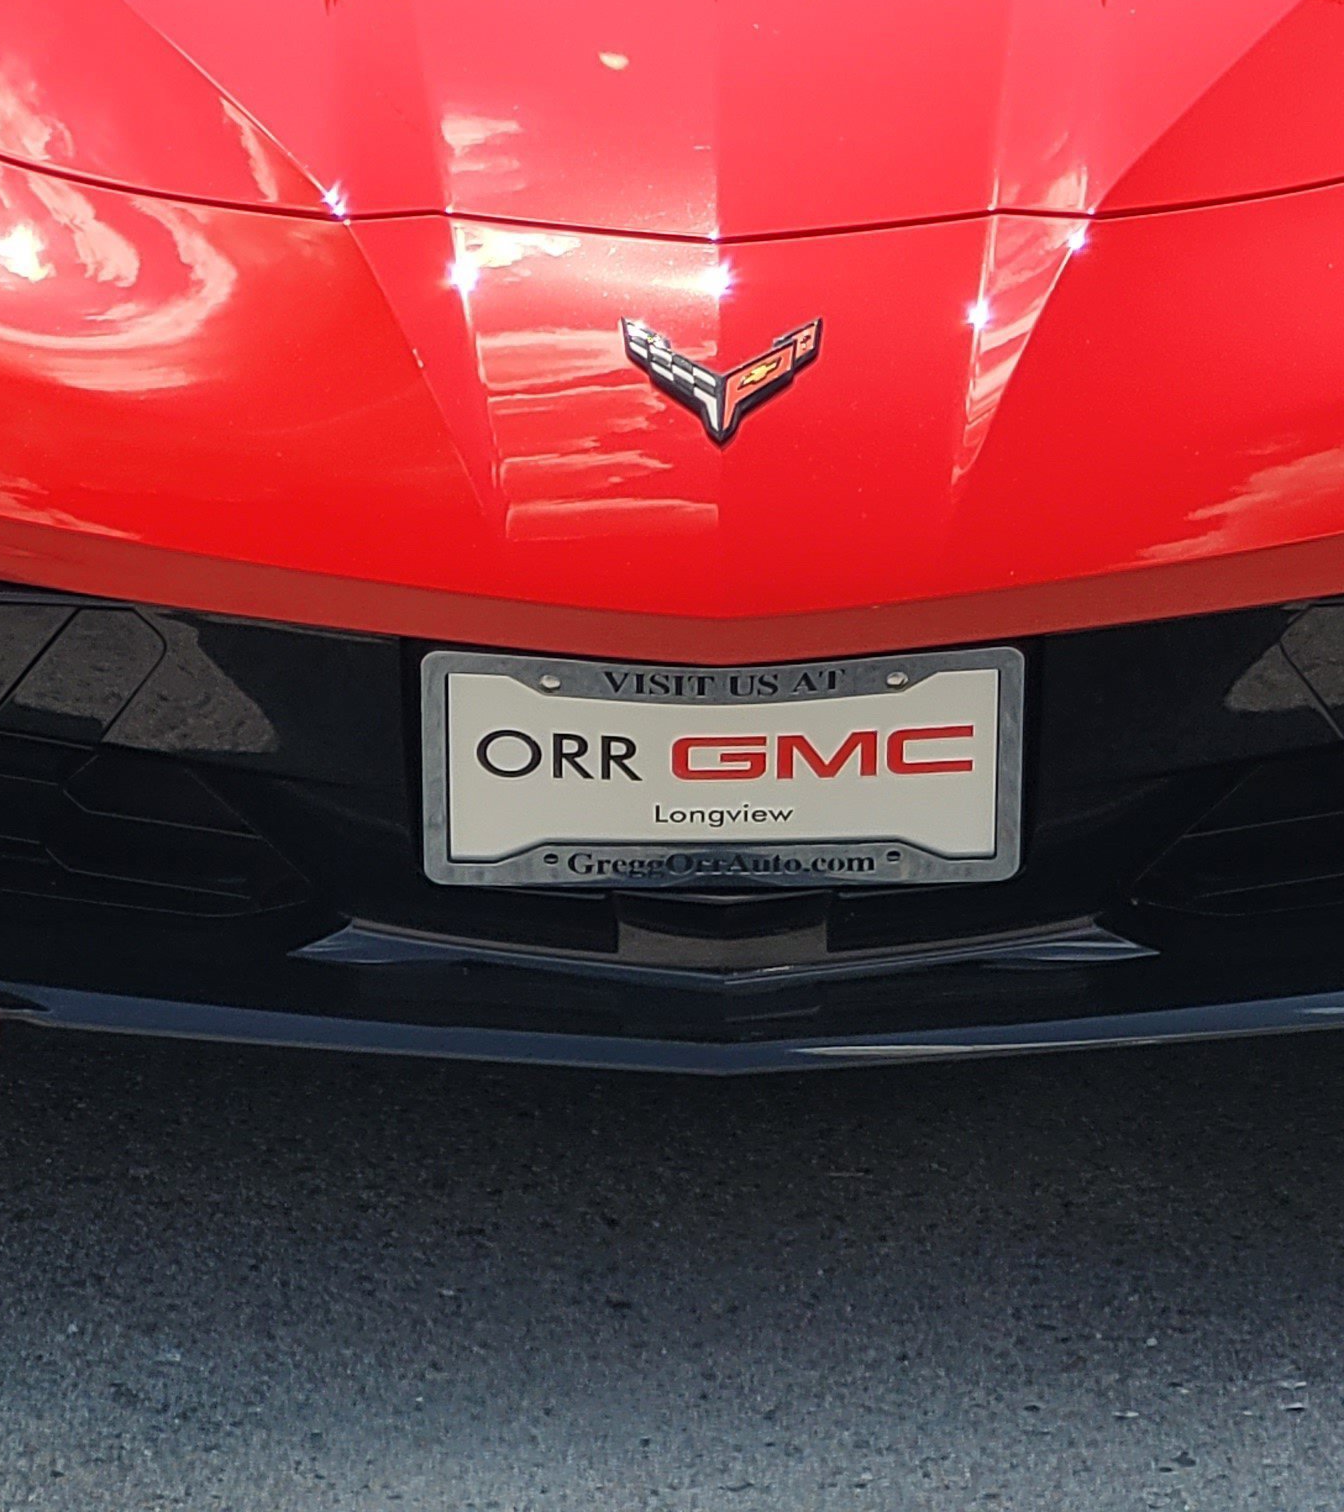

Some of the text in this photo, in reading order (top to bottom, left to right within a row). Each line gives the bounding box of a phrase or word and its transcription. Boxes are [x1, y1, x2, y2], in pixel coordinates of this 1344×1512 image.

[602, 669, 846, 698] VISIT US AT
[476, 725, 974, 782] ORR GMC
[655, 804, 794, 827] Longview
[567, 851, 876, 879] GreggOrrAuto.com
